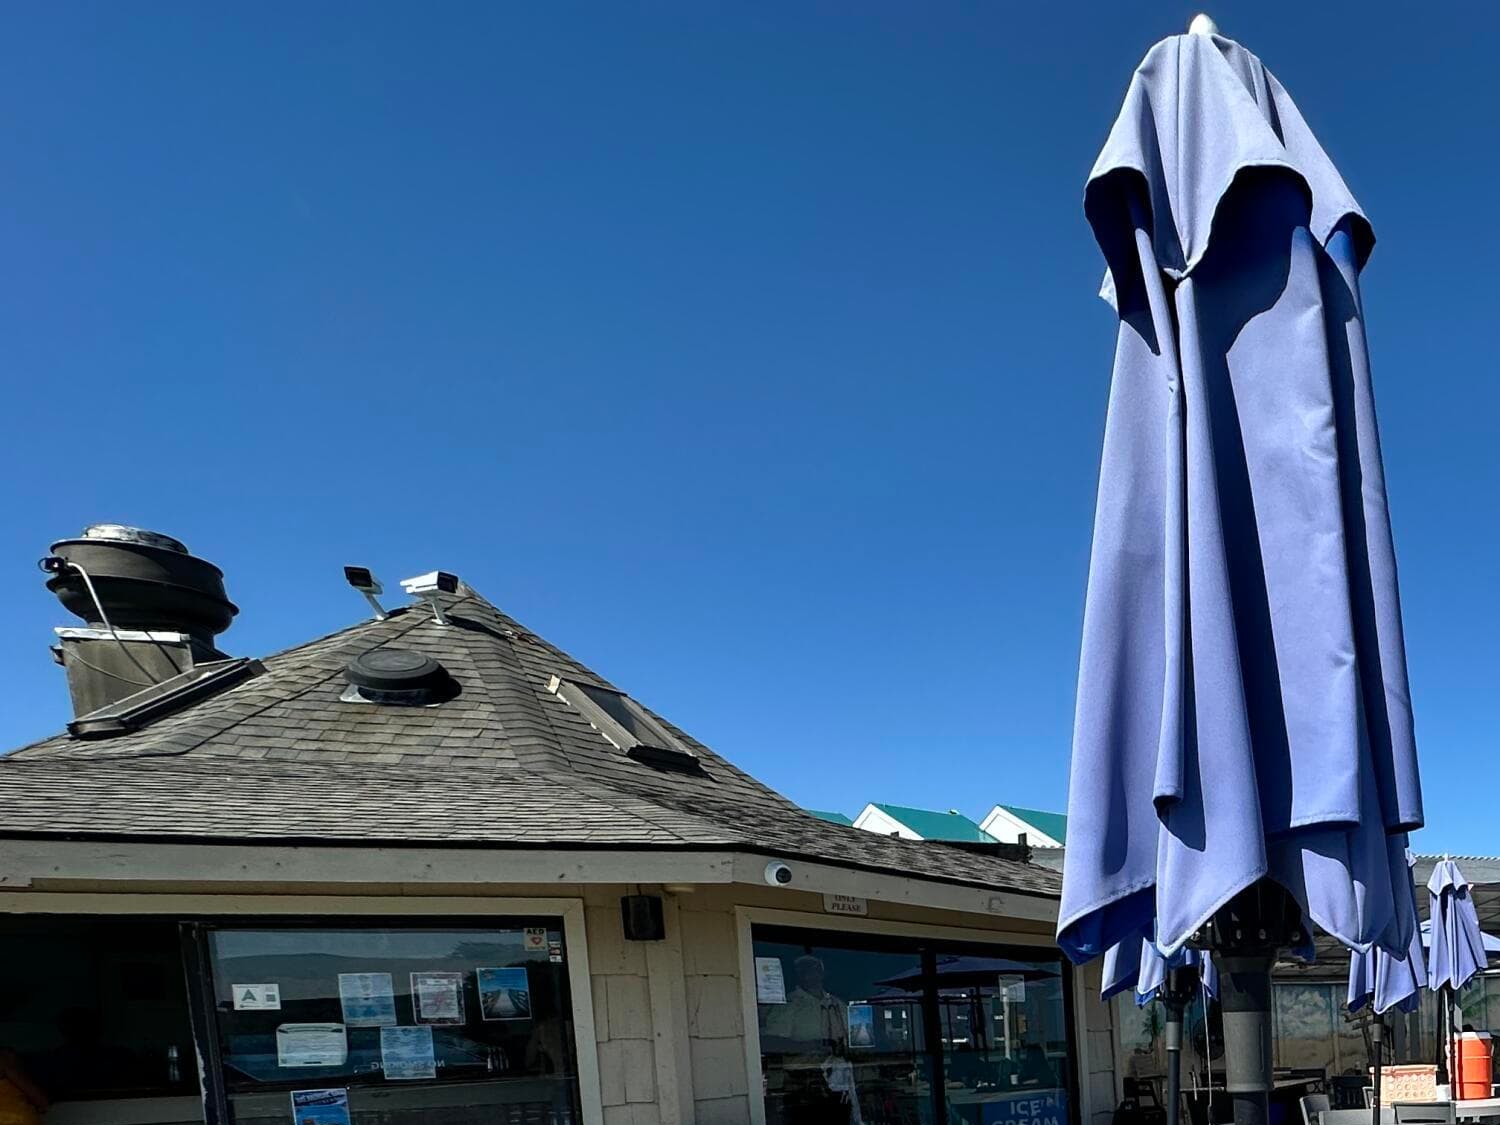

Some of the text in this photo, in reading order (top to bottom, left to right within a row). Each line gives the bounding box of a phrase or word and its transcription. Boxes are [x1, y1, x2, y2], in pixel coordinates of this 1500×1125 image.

[831, 902, 861, 913] PLEASE
[526, 928, 545, 936] AED
[241, 988, 257, 1002] A
[1010, 1100, 1041, 1117] ICE
